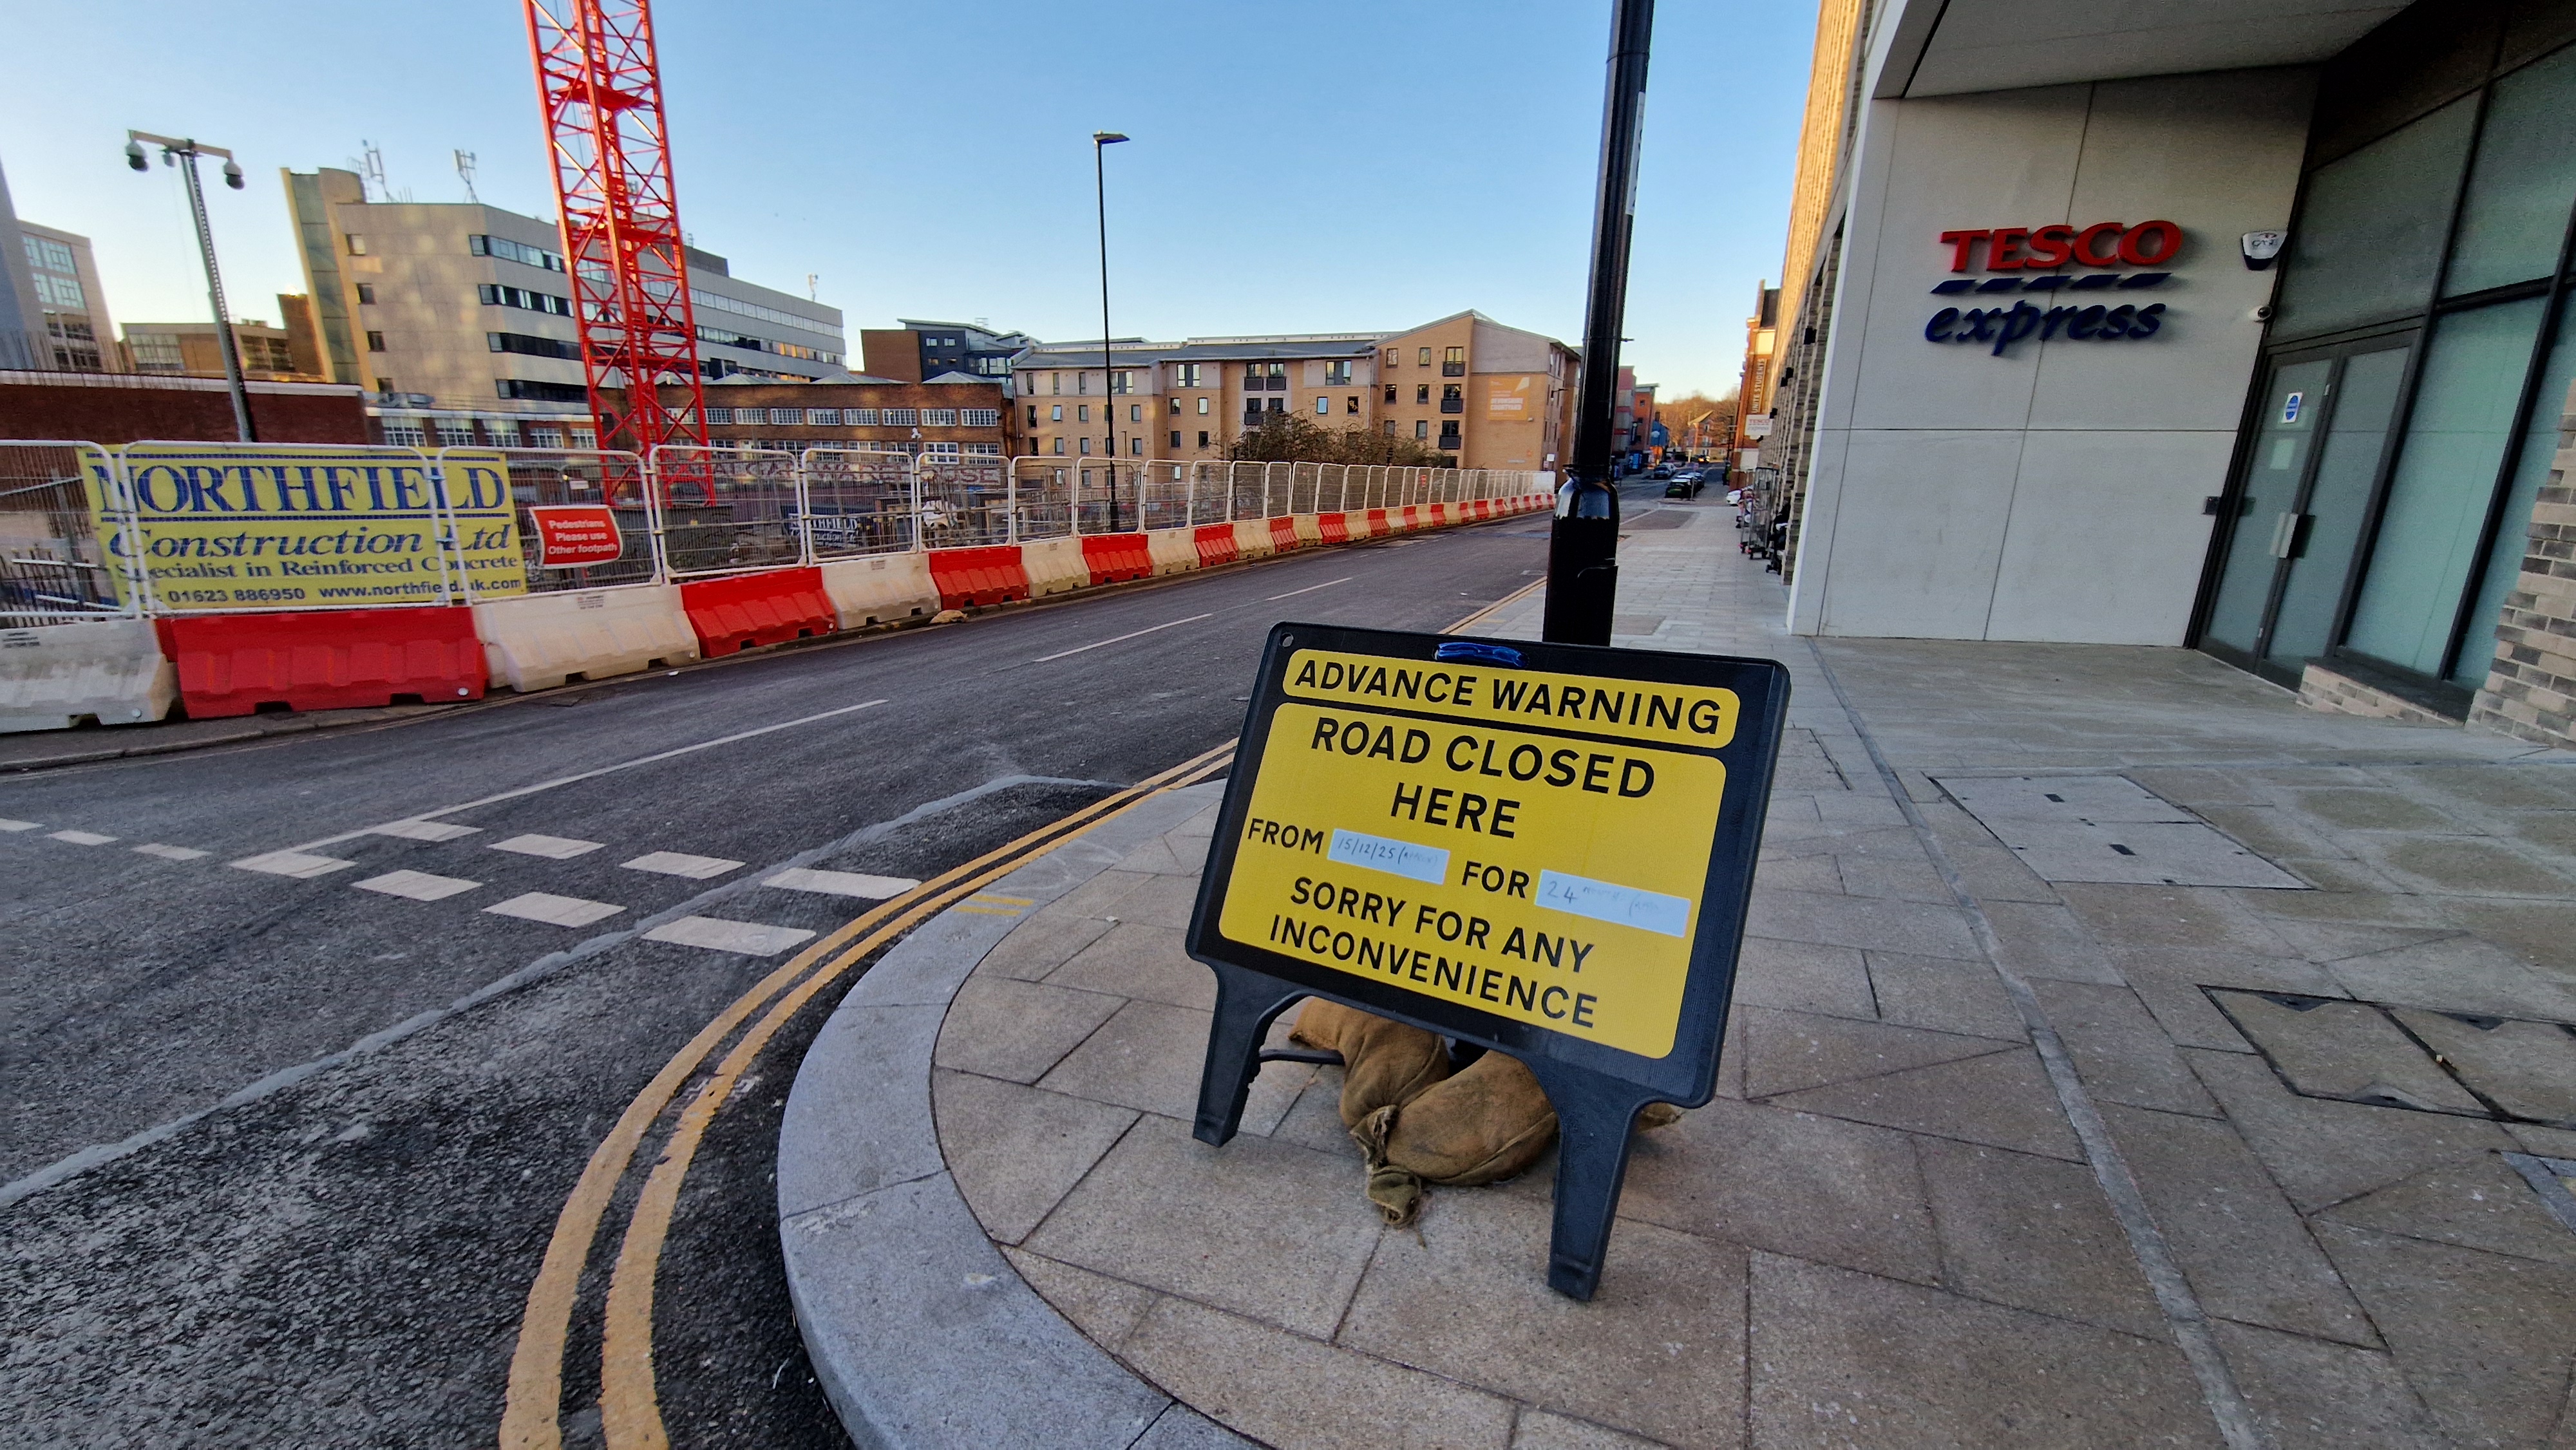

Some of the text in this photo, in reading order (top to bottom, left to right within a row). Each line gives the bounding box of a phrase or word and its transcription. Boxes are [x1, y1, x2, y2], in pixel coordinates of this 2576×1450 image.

[1940, 220, 2184, 272] TESCO
[1924, 299, 2166, 357] express
[1752, 359, 1765, 413] UNITE STUDENTS
[109, 523, 511, 558] Construction Ltd
[548, 543, 618, 554] Other footpath
[555, 532, 588, 541] Please
[246, 561, 272, 577] in
[280, 558, 414, 576] Reinforced
[168, 589, 229, 603] 01623
[234, 588, 306, 602] 886950
[1294, 659, 1721, 735] ADVANCE WARNING
[1311, 716, 1656, 799] ROAD CLOSED
[1390, 782, 1522, 839] HERE
[1247, 817, 1325, 855] FROM
[1461, 860, 1531, 899] FOR
[1547, 880, 1578, 904] 24
[1290, 876, 1596, 974] SORRY FOR ANY
[1269, 914, 1598, 1029] INCONVENIENCE
